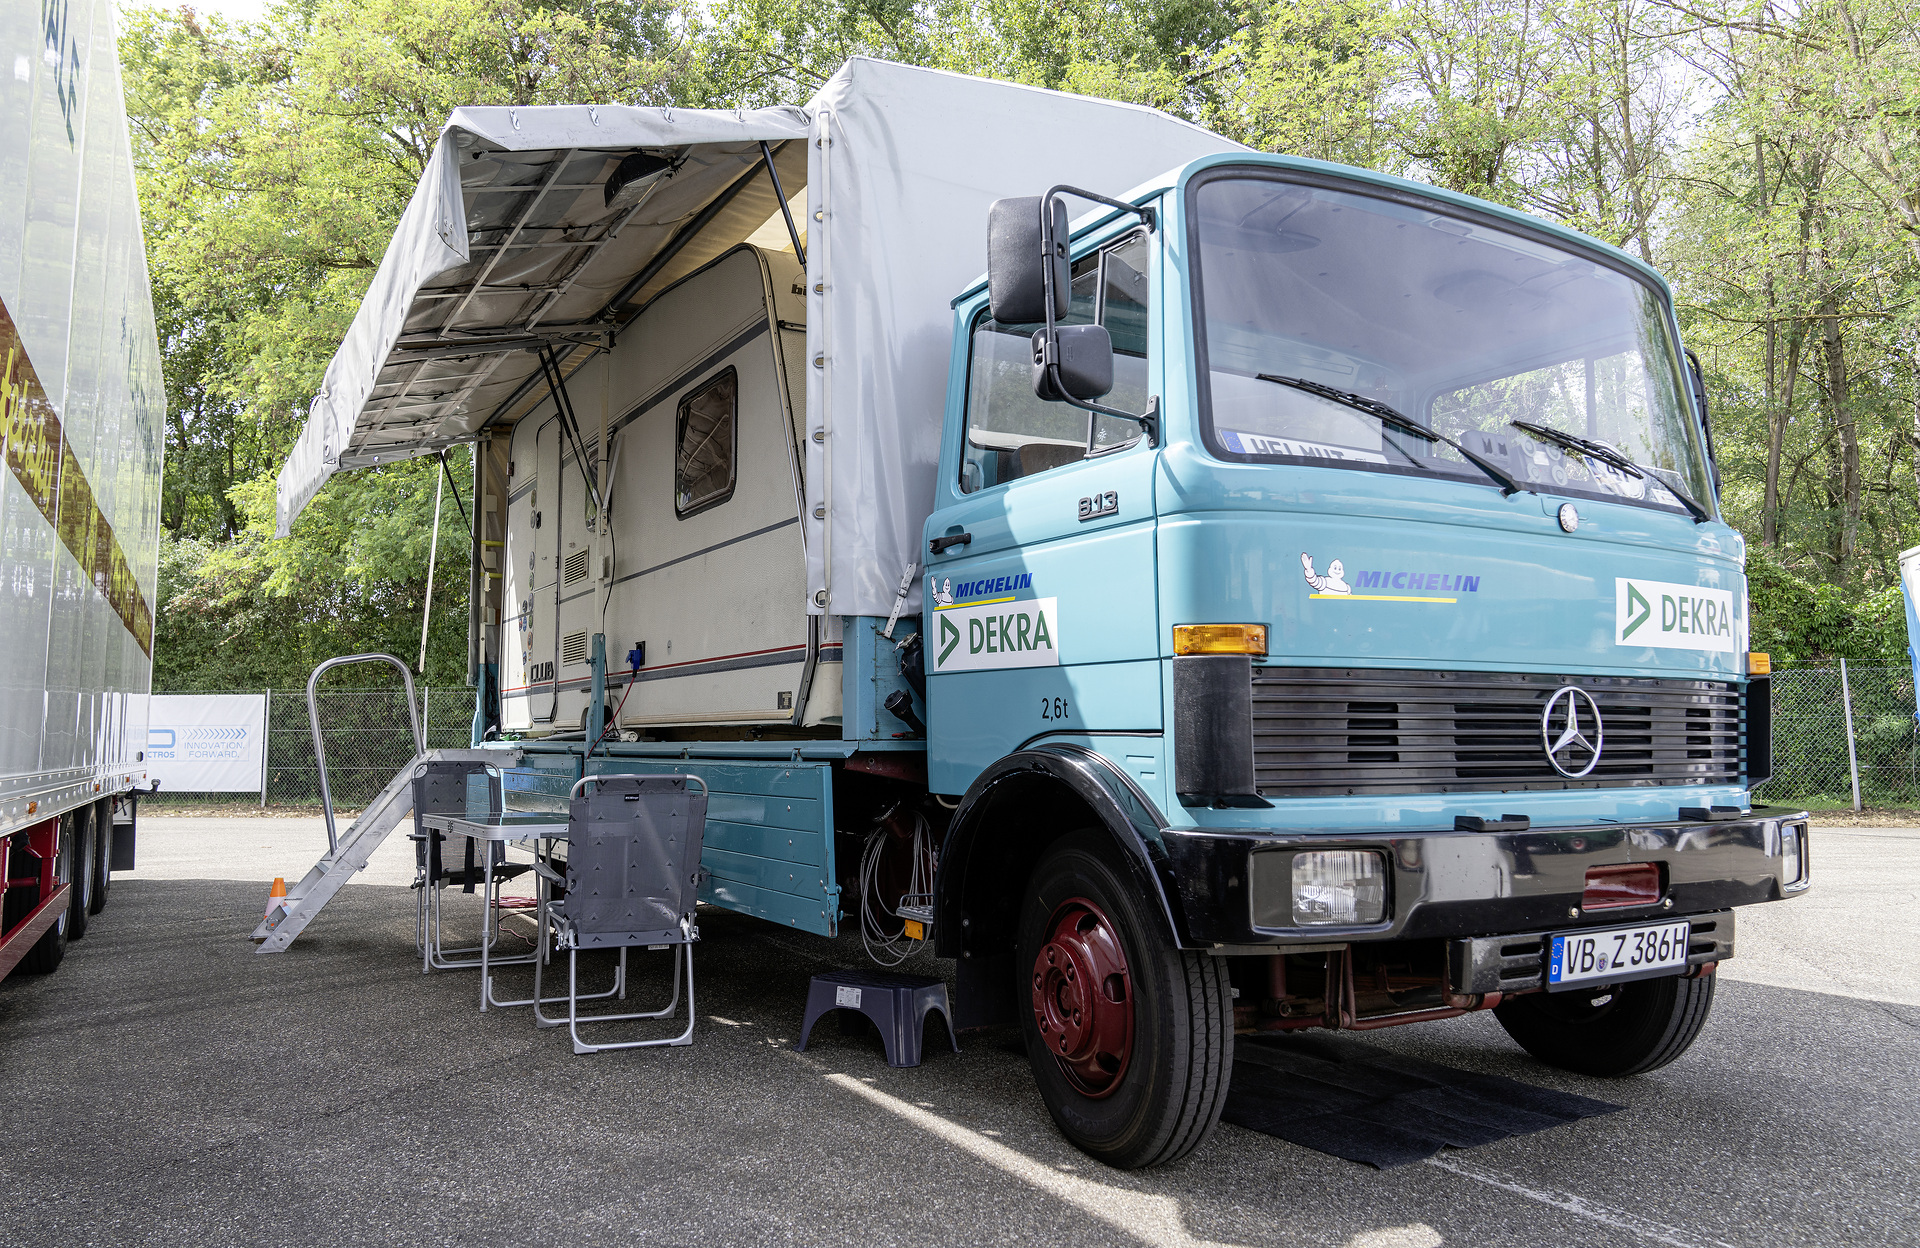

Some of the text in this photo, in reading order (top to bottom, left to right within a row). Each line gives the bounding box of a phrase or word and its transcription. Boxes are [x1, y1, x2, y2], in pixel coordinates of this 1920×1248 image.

[0, 347, 54, 514] tetzky
[1078, 490, 1118, 518] 813
[955, 572, 1033, 598] MICHELIN
[1355, 570, 1481, 592] MICHELIN
[1662, 594, 1731, 637] DEKRA
[968, 609, 1053, 655] DEKRA
[530, 661, 554, 683] CLUB
[147, 751, 175, 759] CTROS
[184, 741, 245, 750] INNOVATION.
[1552, 926, 1687, 975] D VB Z 386H
